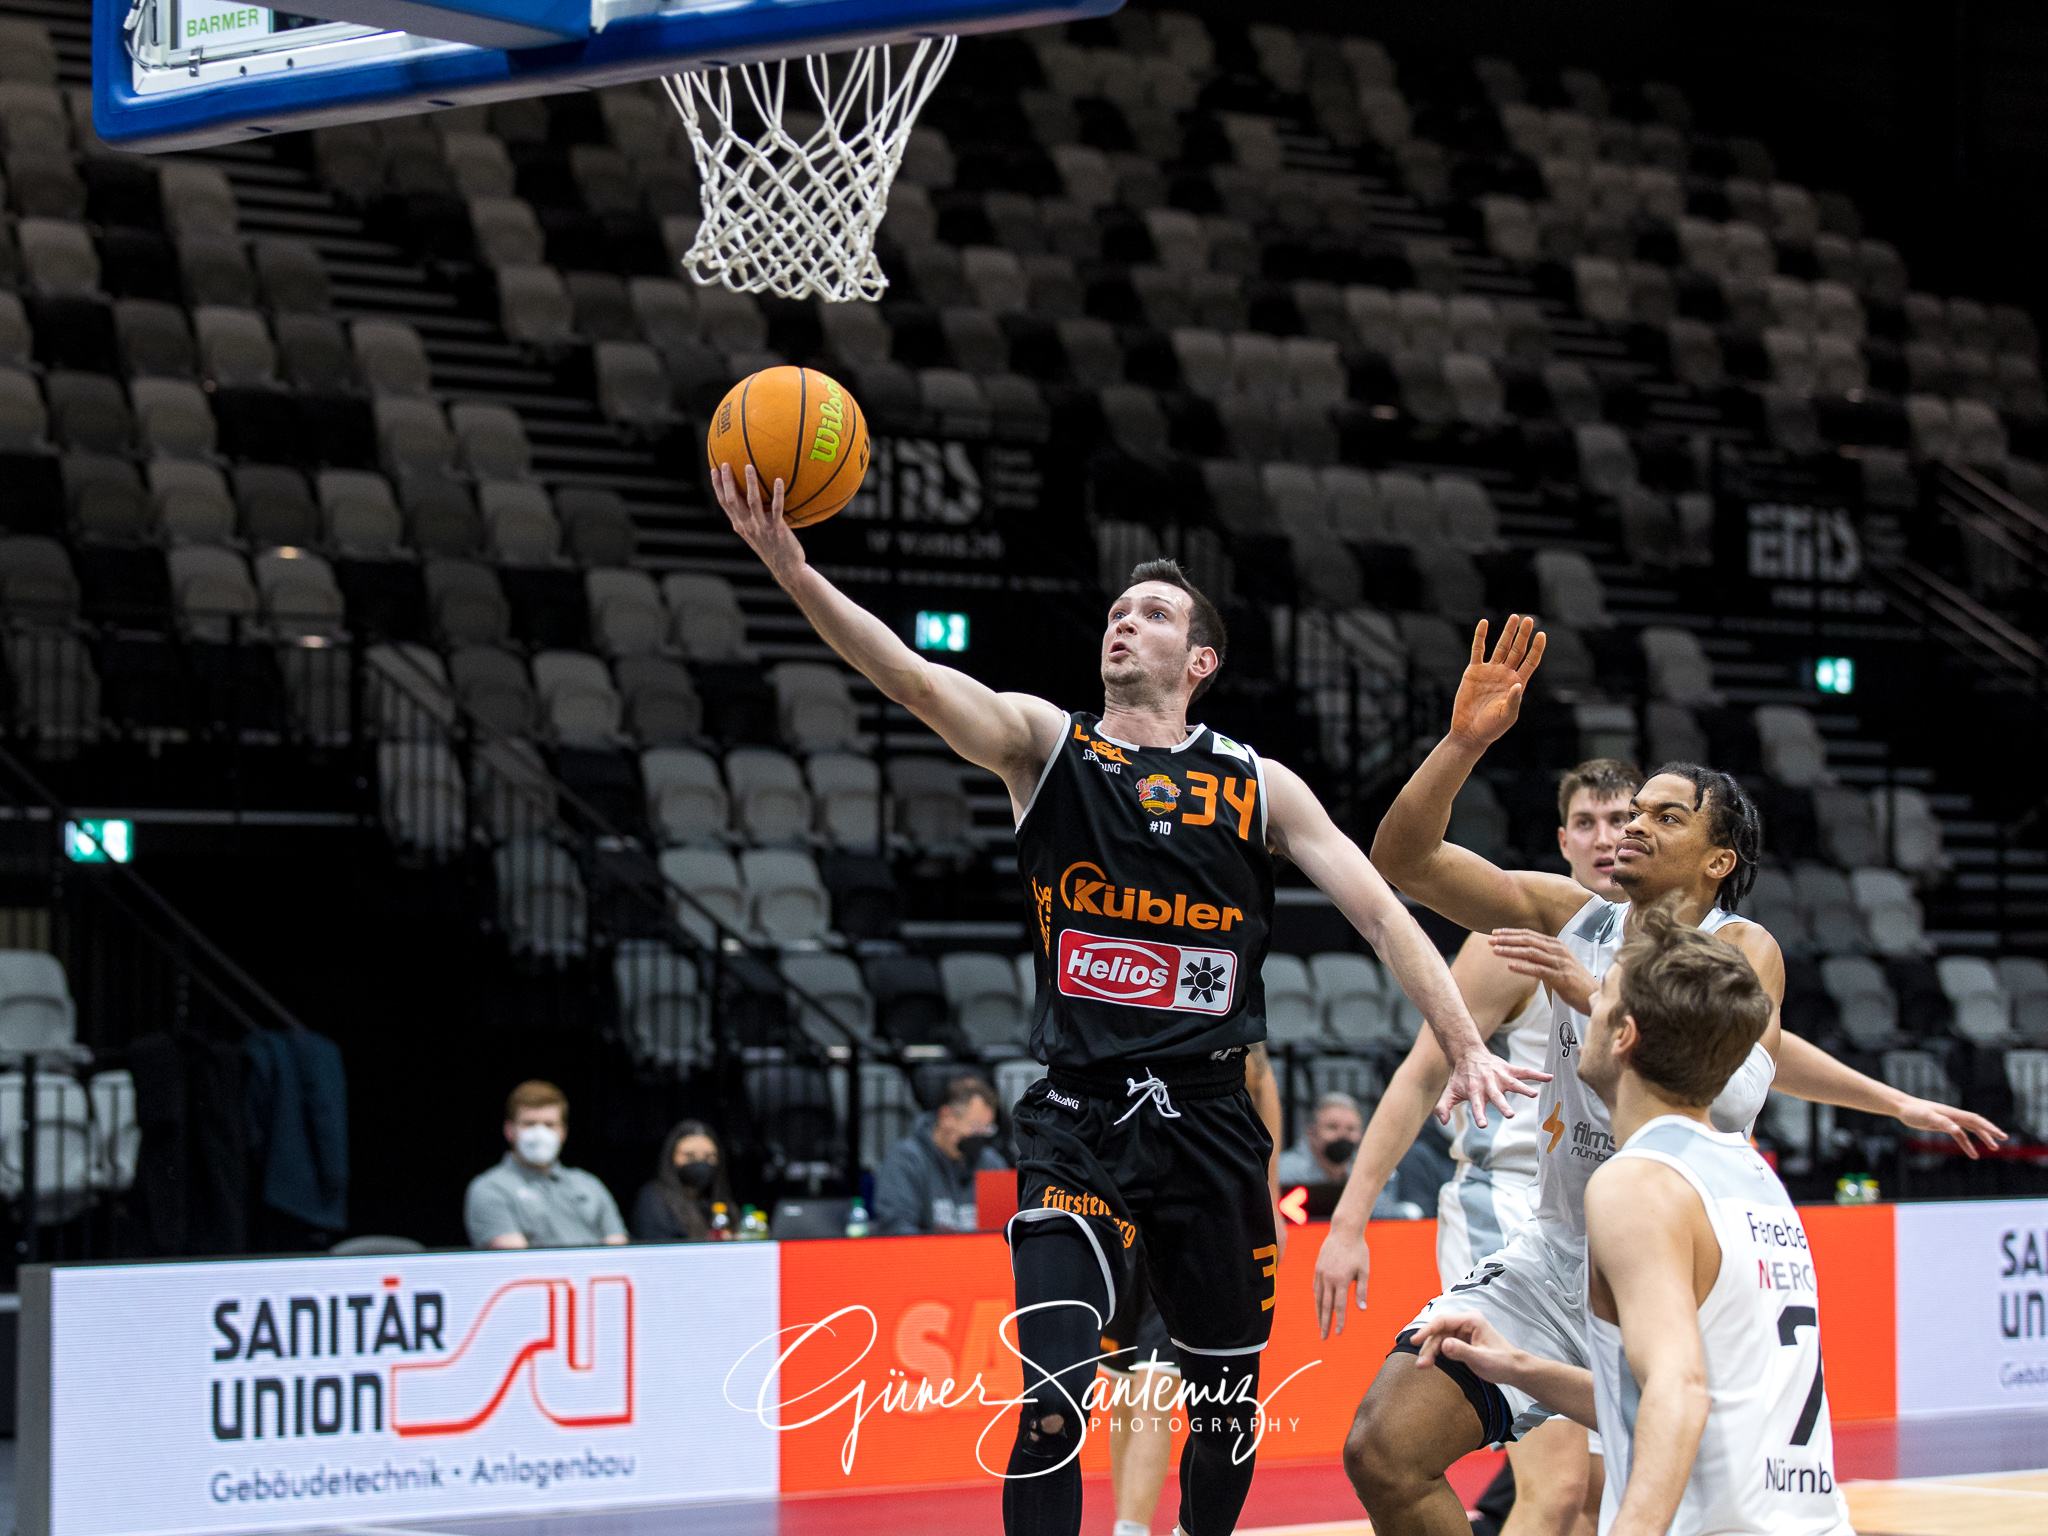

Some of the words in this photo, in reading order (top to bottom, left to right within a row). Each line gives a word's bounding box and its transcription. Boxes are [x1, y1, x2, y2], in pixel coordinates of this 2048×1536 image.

[186, 7, 260, 38] BARMER
[1149, 820, 1172, 836] #10
[1181, 770, 1258, 841] 34
[1073, 877, 1244, 932] Kübler
[1067, 949, 1169, 988] Helios
[2001, 1231, 2048, 1277] SA
[213, 1276, 445, 1362] SANITÄR
[2001, 1292, 2046, 1338] UN
[891, 1301, 1018, 1416] SA
[1777, 1305, 1824, 1446] 7
[212, 1372, 384, 1441] UNION
[211, 1460, 445, 1504] Gebäudetechnik
[471, 1447, 637, 1489] Anlagenbau
[1765, 1456, 1832, 1494] Nürnb
